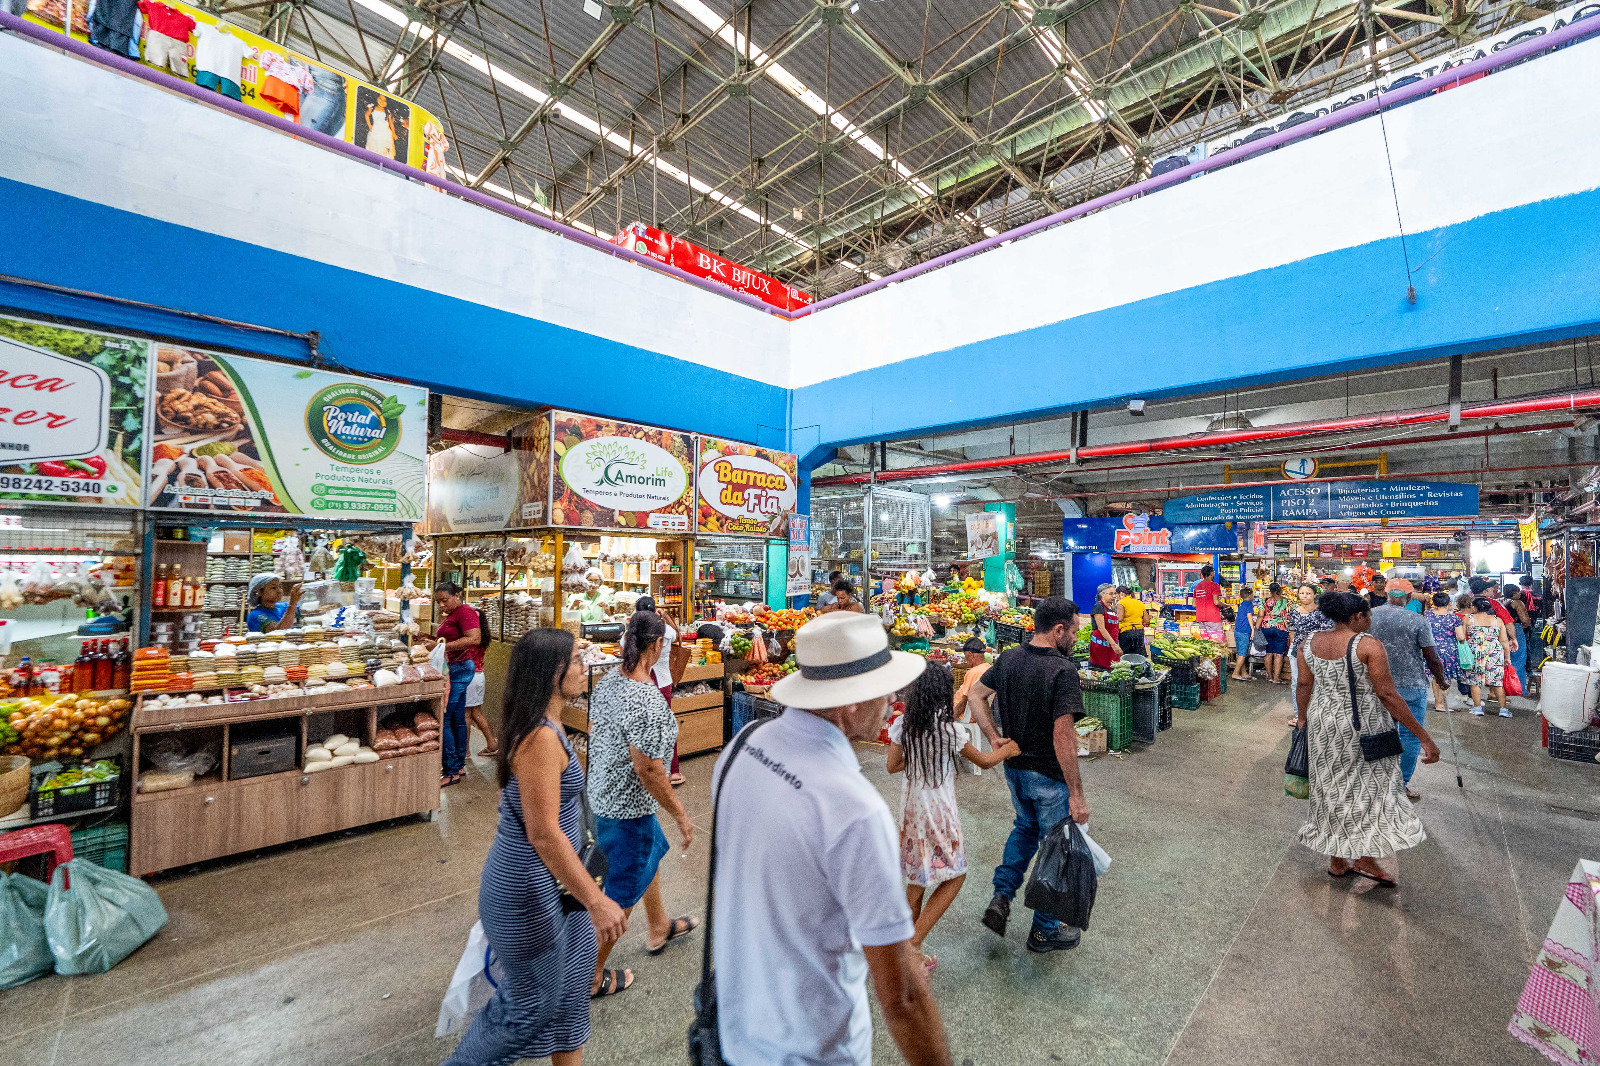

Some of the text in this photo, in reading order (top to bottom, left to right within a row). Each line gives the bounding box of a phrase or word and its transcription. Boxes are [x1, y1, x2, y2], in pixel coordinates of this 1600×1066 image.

[698, 252, 771, 295] BK BIJUX
[322, 405, 375, 424] Portal
[328, 419, 387, 439] Natural
[320, 438, 387, 460] QUALIDADE ORIGINAL
[329, 464, 374, 475] Temperos
[655, 466, 673, 478] Life
[713, 459, 787, 491] Barraca
[315, 472, 393, 485] Produtos Naturais
[614, 470, 666, 487] Amorim
[0, 476, 101, 494] 98242-5340
[1338, 484, 1430, 495] Bijouterias Miudezas
[582, 487, 613, 497] Temperos
[619, 488, 646, 500] Produtos
[646, 493, 670, 502] Naturais
[1279, 487, 1321, 497] ACESSO
[1338, 494, 1366, 502] Móveis
[1375, 492, 1416, 501] Utensílios
[720, 484, 779, 515] da Fia
[1281, 498, 1315, 507] PISO 2
[1338, 500, 1439, 510] Importados Brinquedos
[1200, 514, 1225, 522] Juizado
[1282, 508, 1318, 517] RAMPA
[1338, 509, 1366, 518] Artigos
[727, 523, 745, 532] Coco
[744, 743, 803, 790] rolhardireto
